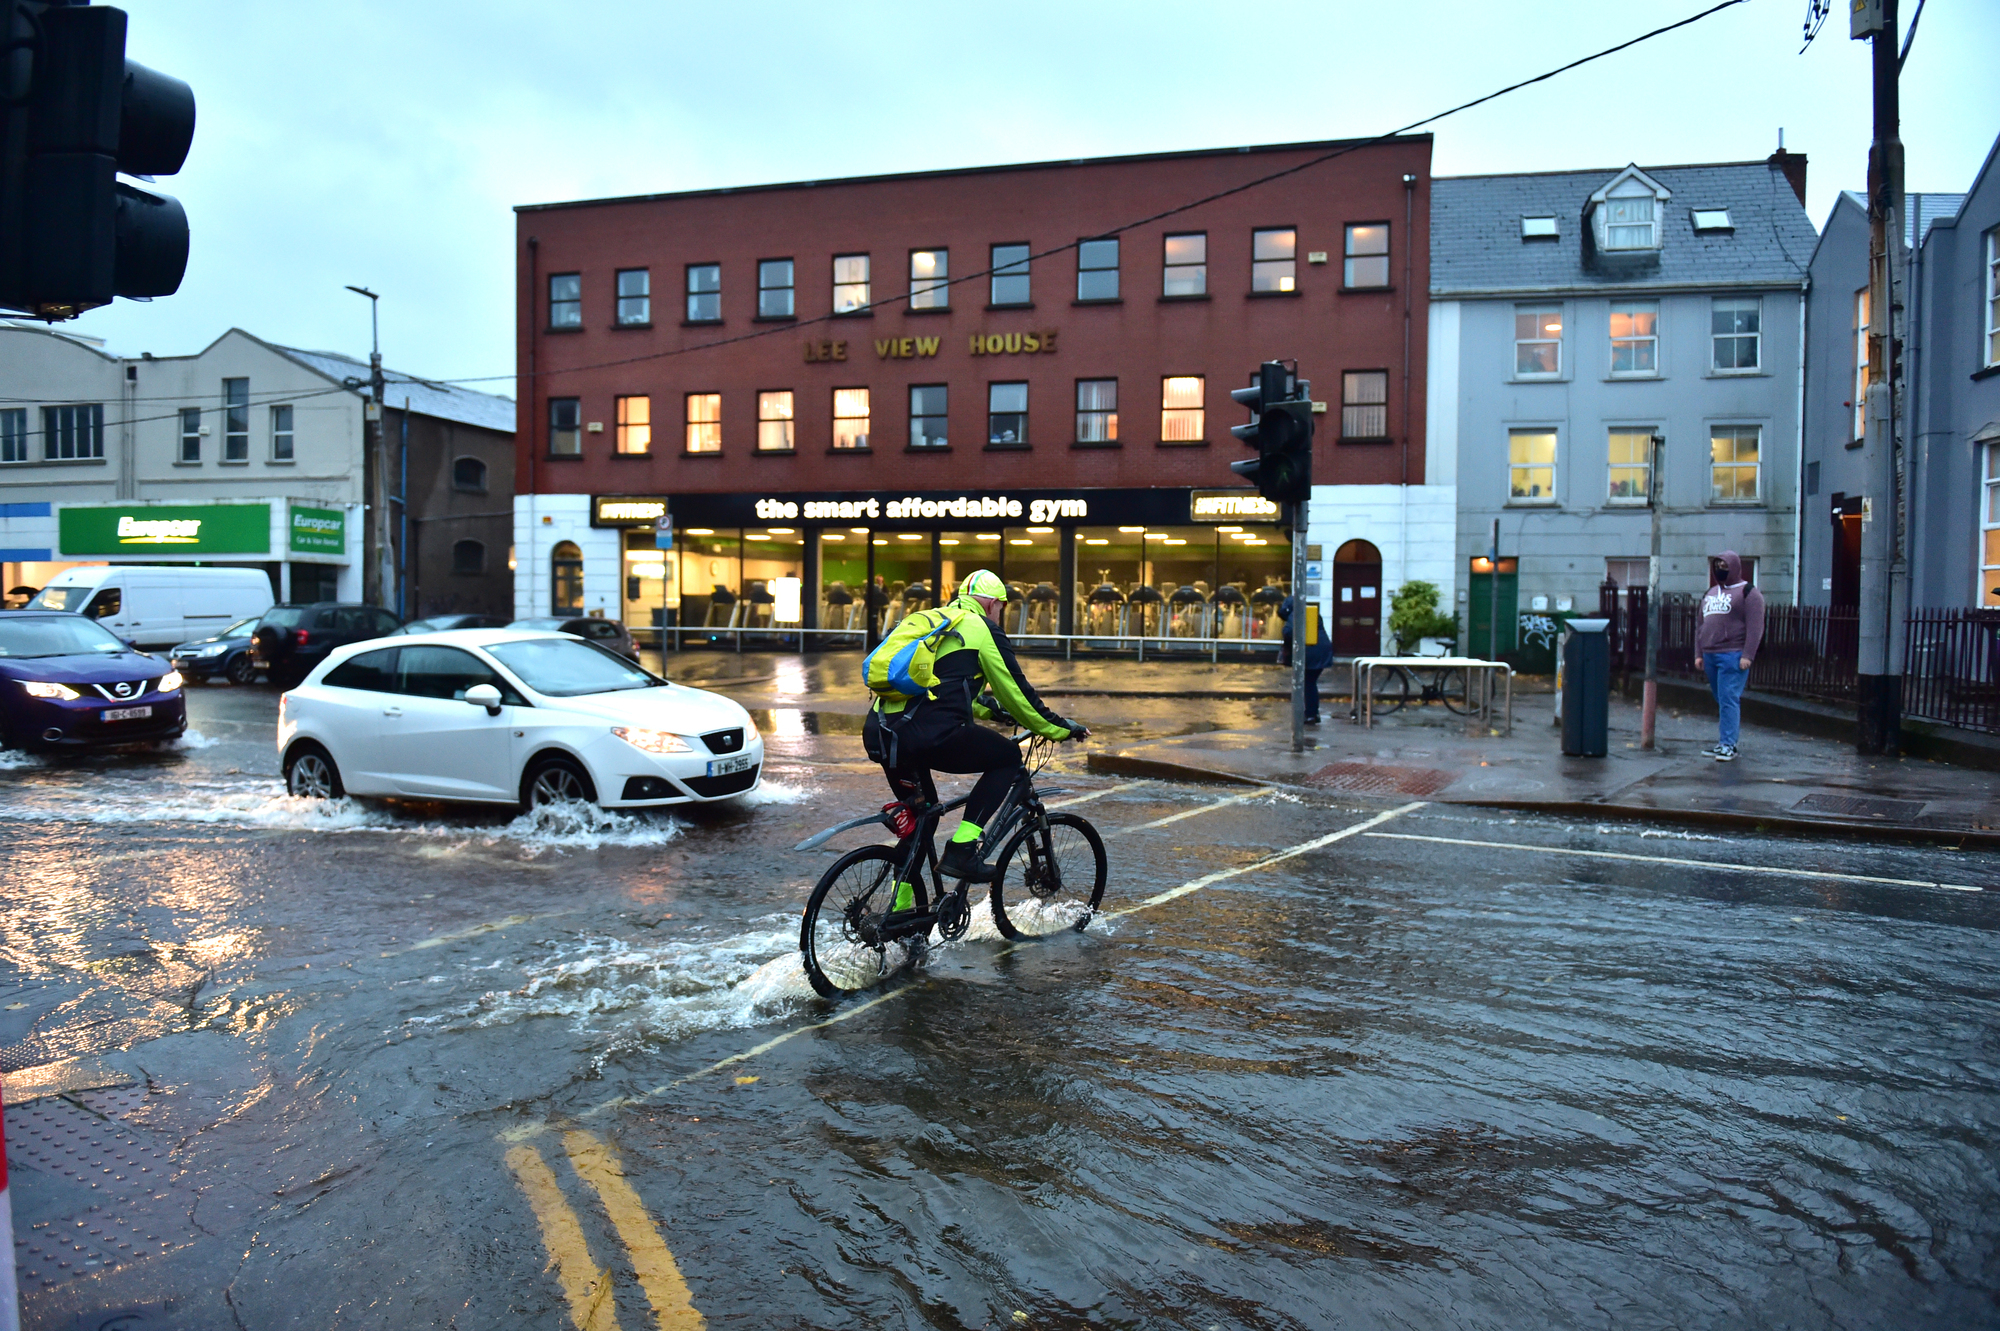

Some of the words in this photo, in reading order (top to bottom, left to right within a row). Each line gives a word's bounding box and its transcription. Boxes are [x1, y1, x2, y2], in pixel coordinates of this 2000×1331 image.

[804, 339, 848, 362] LEE
[875, 336, 940, 358] VIEW
[969, 330, 1057, 357] HOUSE
[755, 498, 798, 519] the
[803, 498, 880, 519] smart
[885, 497, 1022, 518] affordable
[1029, 498, 1087, 522] gym
[118, 516, 201, 543] Europcar
[294, 514, 341, 532] Europcar
